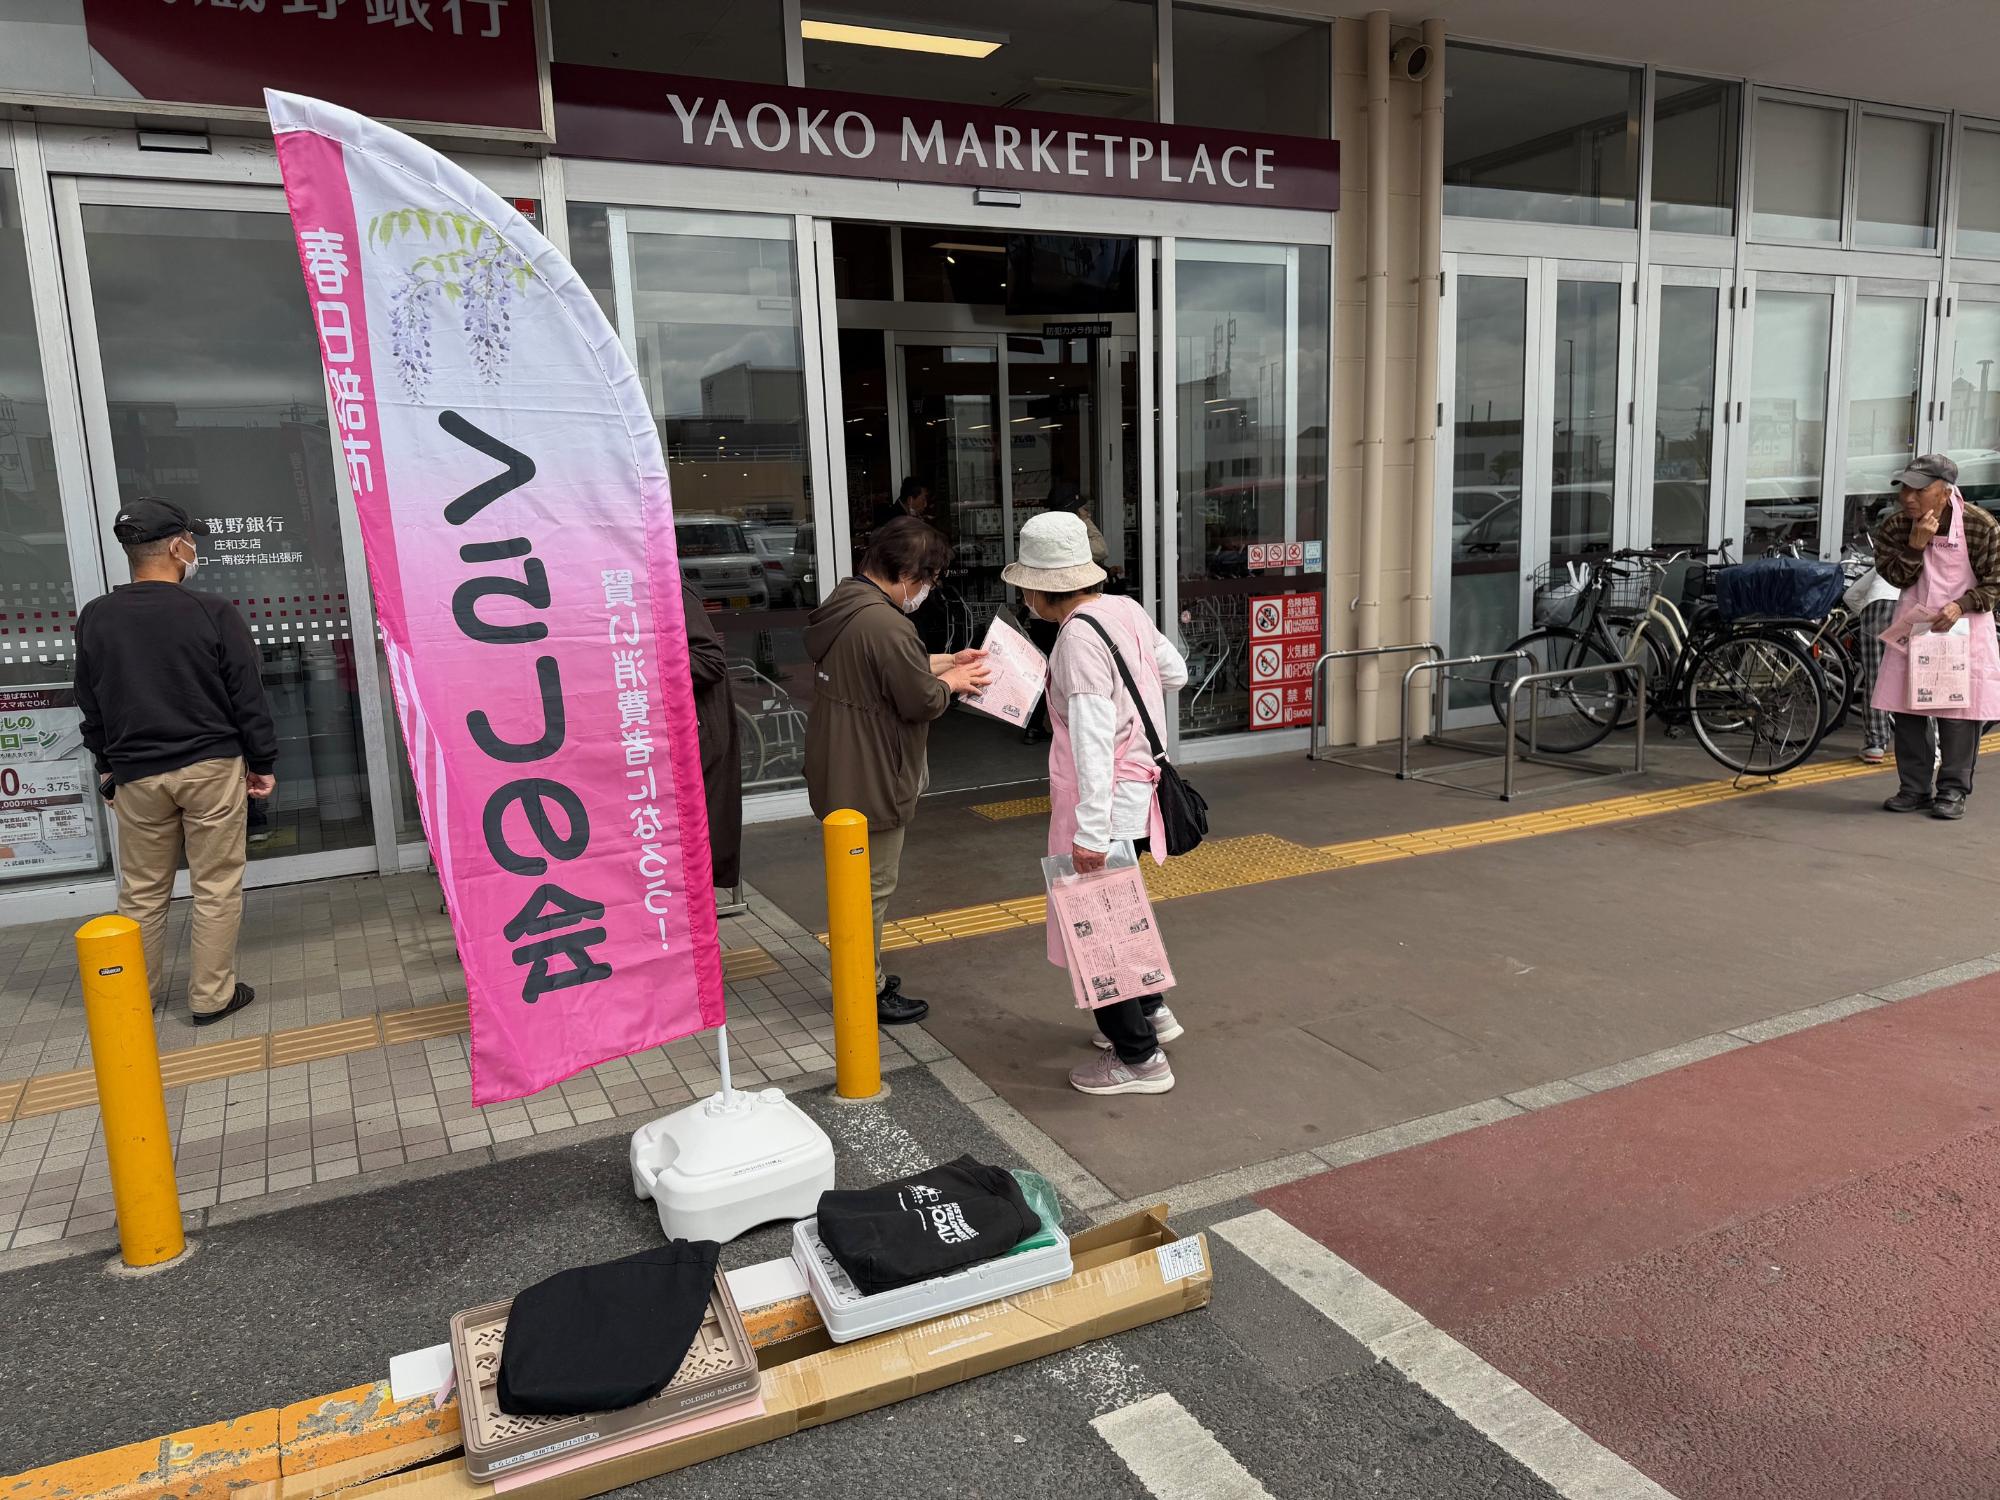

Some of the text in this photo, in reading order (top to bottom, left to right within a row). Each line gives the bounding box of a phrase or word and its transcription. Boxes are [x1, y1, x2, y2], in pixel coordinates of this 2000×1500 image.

[666, 93, 1275, 190] YAOKO MARKETPLACE
[195, 516, 285, 534] 蔵野銀行
[214, 538, 261, 551] 庄和支店
[1284, 663, 1293, 679] NO
[1284, 707, 1293, 723] NO
[680, 1381, 749, 1407] FOLDING BASKET
